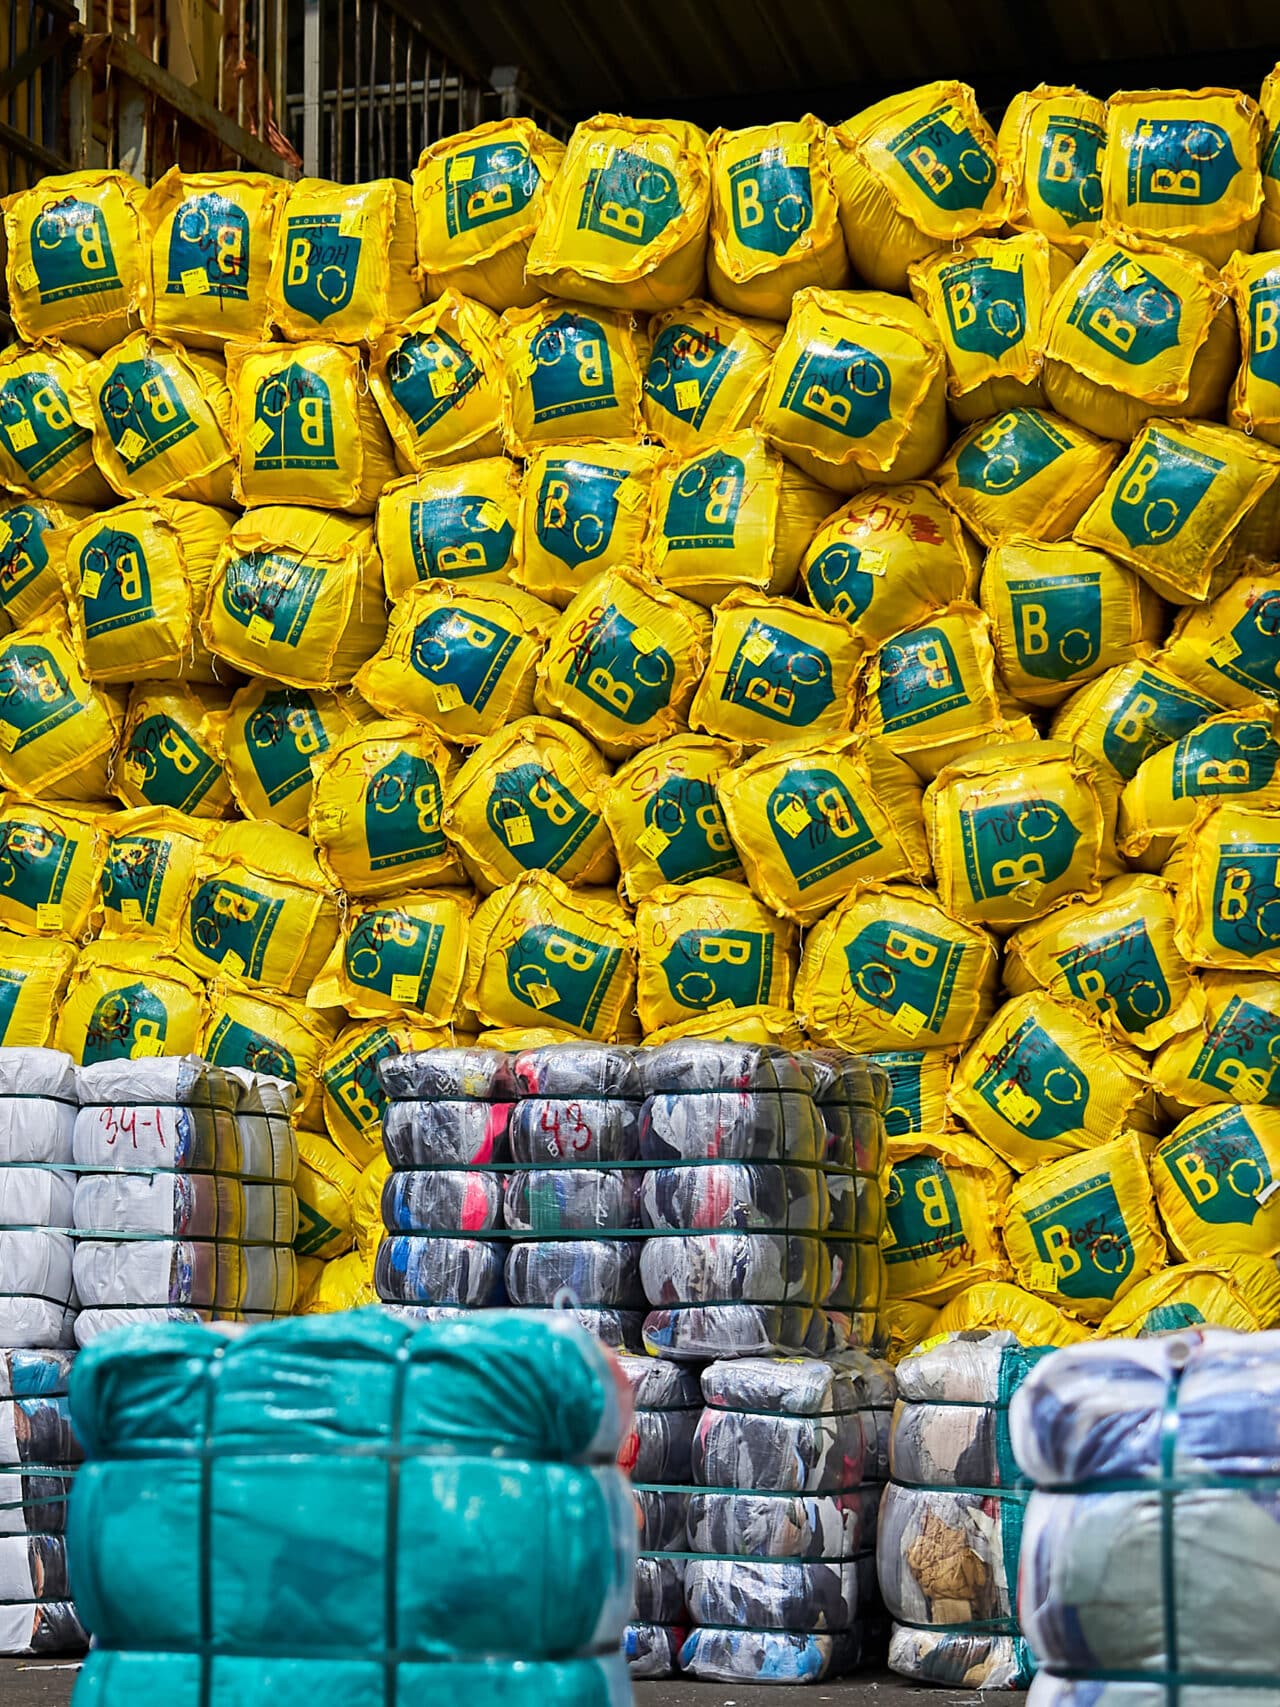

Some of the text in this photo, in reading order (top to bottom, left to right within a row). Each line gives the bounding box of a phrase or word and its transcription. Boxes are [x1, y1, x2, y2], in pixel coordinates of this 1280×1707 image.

[909, 145, 953, 195] B
[1046, 134, 1076, 182] B
[467, 184, 513, 219] B
[737, 179, 763, 228] B
[1151, 169, 1200, 196] B
[599, 201, 644, 237] B
[76, 223, 106, 269] B
[288, 239, 310, 285] B
[949, 282, 976, 330] B
[1089, 307, 1136, 352] B
[576, 340, 603, 386] B
[33, 387, 72, 430] B
[142, 376, 176, 423] B
[299, 398, 324, 445] B
[540, 398, 607, 418] HOLLAND
[803, 385, 851, 426] B
[974, 414, 1018, 451] B
[705, 477, 735, 524] B
[1120, 454, 1159, 505] B
[117, 551, 142, 601] B
[437, 542, 487, 571] B
[1018, 575, 1089, 589] HOLLAND
[447, 614, 496, 647] B
[1022, 604, 1048, 655] B
[477, 641, 514, 702] HOLLAND
[918, 640, 952, 688] B
[587, 666, 634, 714] B
[890, 698, 959, 728] HOLLAND
[287, 709, 319, 754] B
[1114, 692, 1158, 743] B
[159, 729, 200, 775] B
[1197, 759, 1249, 785] B
[414, 784, 440, 833] B
[529, 781, 576, 825] B
[816, 787, 859, 838] B
[804, 845, 870, 882] HOLLAND
[962, 819, 979, 890] HOLLAND
[991, 852, 1045, 888] B
[214, 887, 259, 921] B
[1220, 868, 1251, 920] B
[252, 907, 278, 971] HOLLAND
[374, 917, 418, 946] B
[545, 934, 596, 971] B
[700, 937, 751, 965] B
[885, 930, 938, 968] B
[585, 957, 616, 1022] HOLLAND
[934, 952, 958, 1023] HOLLAND
[100, 1106, 166, 1149] 34-1
[916, 1175, 950, 1227] B
[1033, 1178, 1101, 1216] HOLLAND
[1176, 1154, 1218, 1204] B
[1042, 1224, 1081, 1279] B
